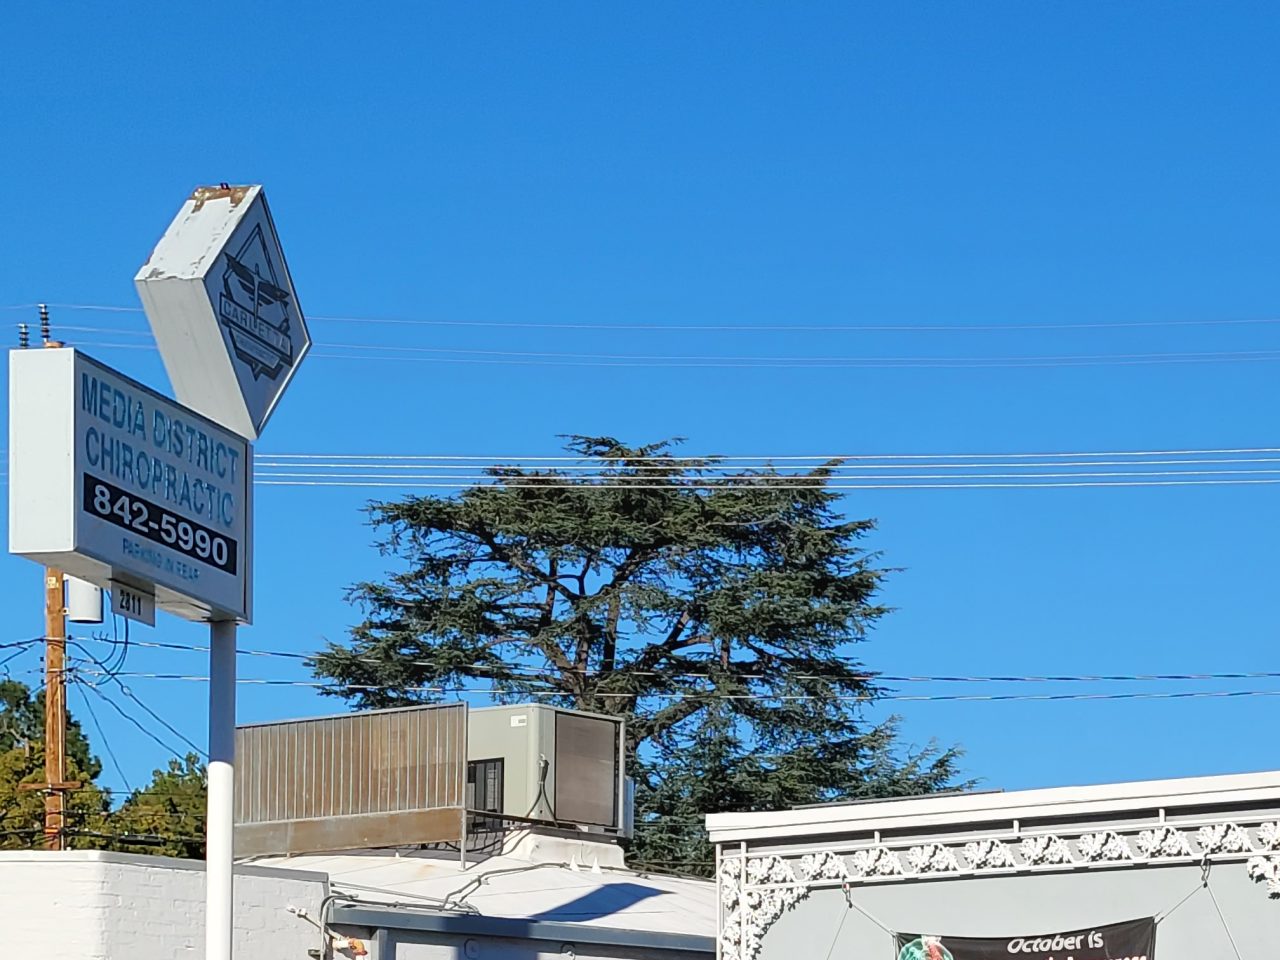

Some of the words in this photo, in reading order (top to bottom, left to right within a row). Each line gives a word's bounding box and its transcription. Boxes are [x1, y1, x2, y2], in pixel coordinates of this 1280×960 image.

[81, 372, 147, 441] MEDIA
[153, 409, 239, 484] DISTRICT
[85, 426, 234, 528] CHIROPRACTIC
[93, 484, 228, 566] 842-5990
[119, 588, 142, 617] 2811
[1007, 935, 1082, 954] October
